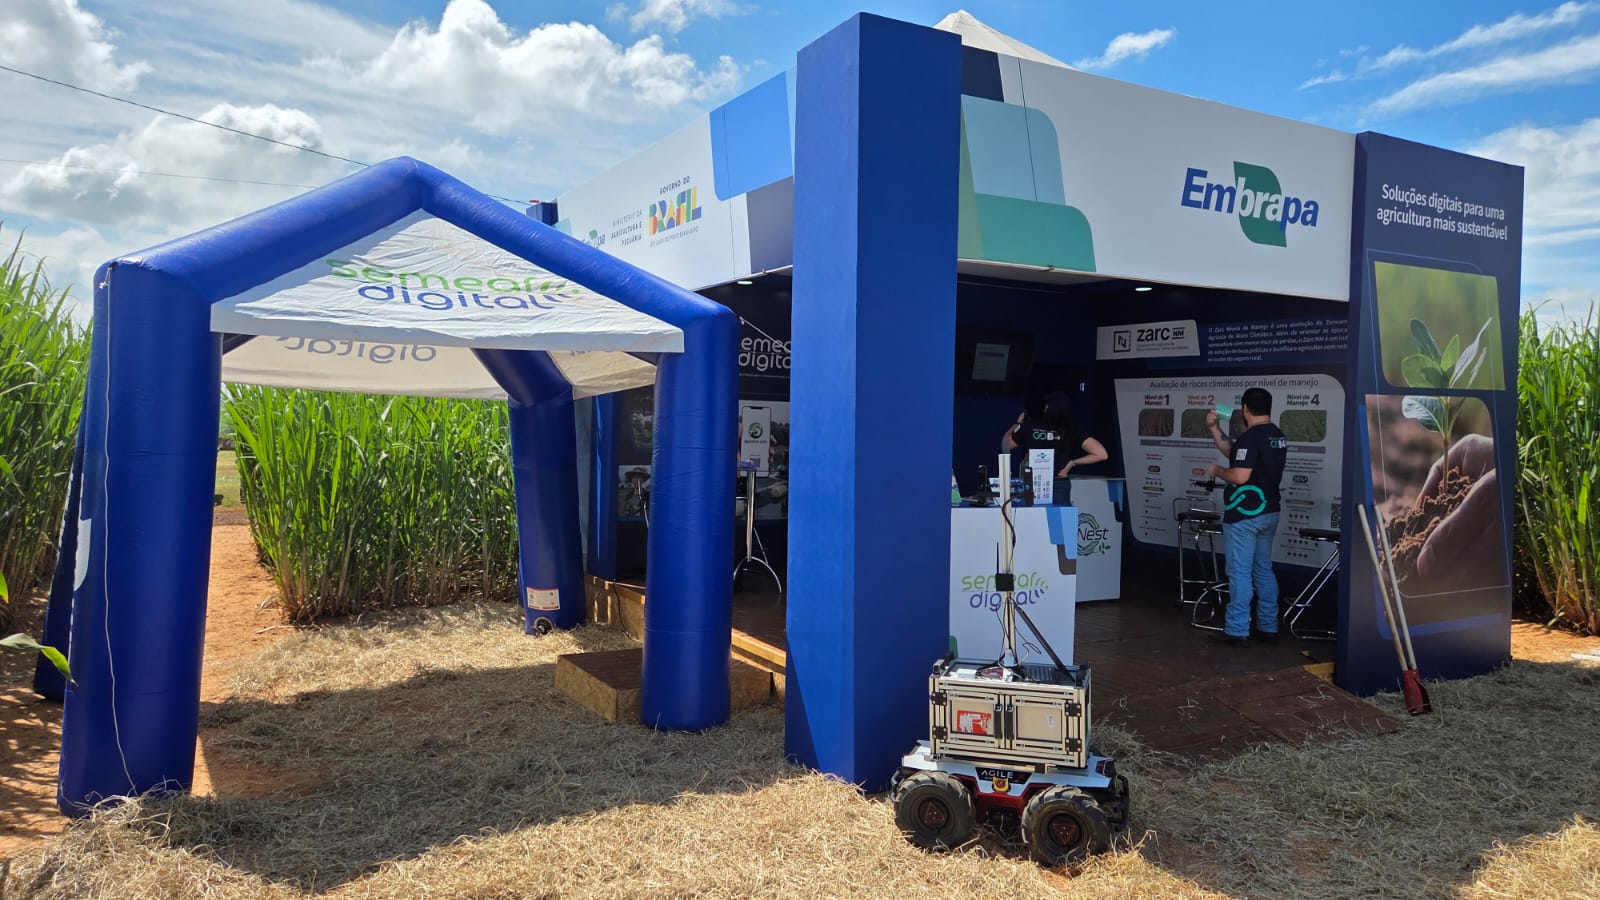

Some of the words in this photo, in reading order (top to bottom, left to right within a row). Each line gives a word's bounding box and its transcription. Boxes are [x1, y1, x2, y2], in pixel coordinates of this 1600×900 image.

[1180, 166, 1320, 232] Embrapa
[1381, 182, 1428, 208] Soluções
[1428, 188, 1463, 215] digitais
[1463, 198, 1484, 218] para
[1485, 205, 1505, 221] uma
[649, 185, 702, 236] BRASIL
[1376, 205, 1432, 229] agricultura
[1433, 213, 1456, 233] mais
[1457, 219, 1508, 242] sustentável
[325, 258, 553, 294] semear
[358, 284, 554, 311] digital
[1136, 327, 1170, 343] zarc
[1172, 329, 1184, 339] NM
[738, 352, 791, 372] digita
[1150, 379, 1179, 390] Avaliação
[1179, 379, 1188, 388] de
[1189, 379, 1208, 389] riscos
[1208, 377, 1244, 389] climáticos
[1244, 379, 1257, 389] por
[1258, 377, 1277, 387] nível
[1277, 378, 1288, 387] de
[1288, 377, 1319, 389] manejo
[1164, 393, 1170, 406] 1
[1207, 394, 1215, 406] 2
[1310, 393, 1320, 406] 4
[970, 588, 1036, 612] digal
